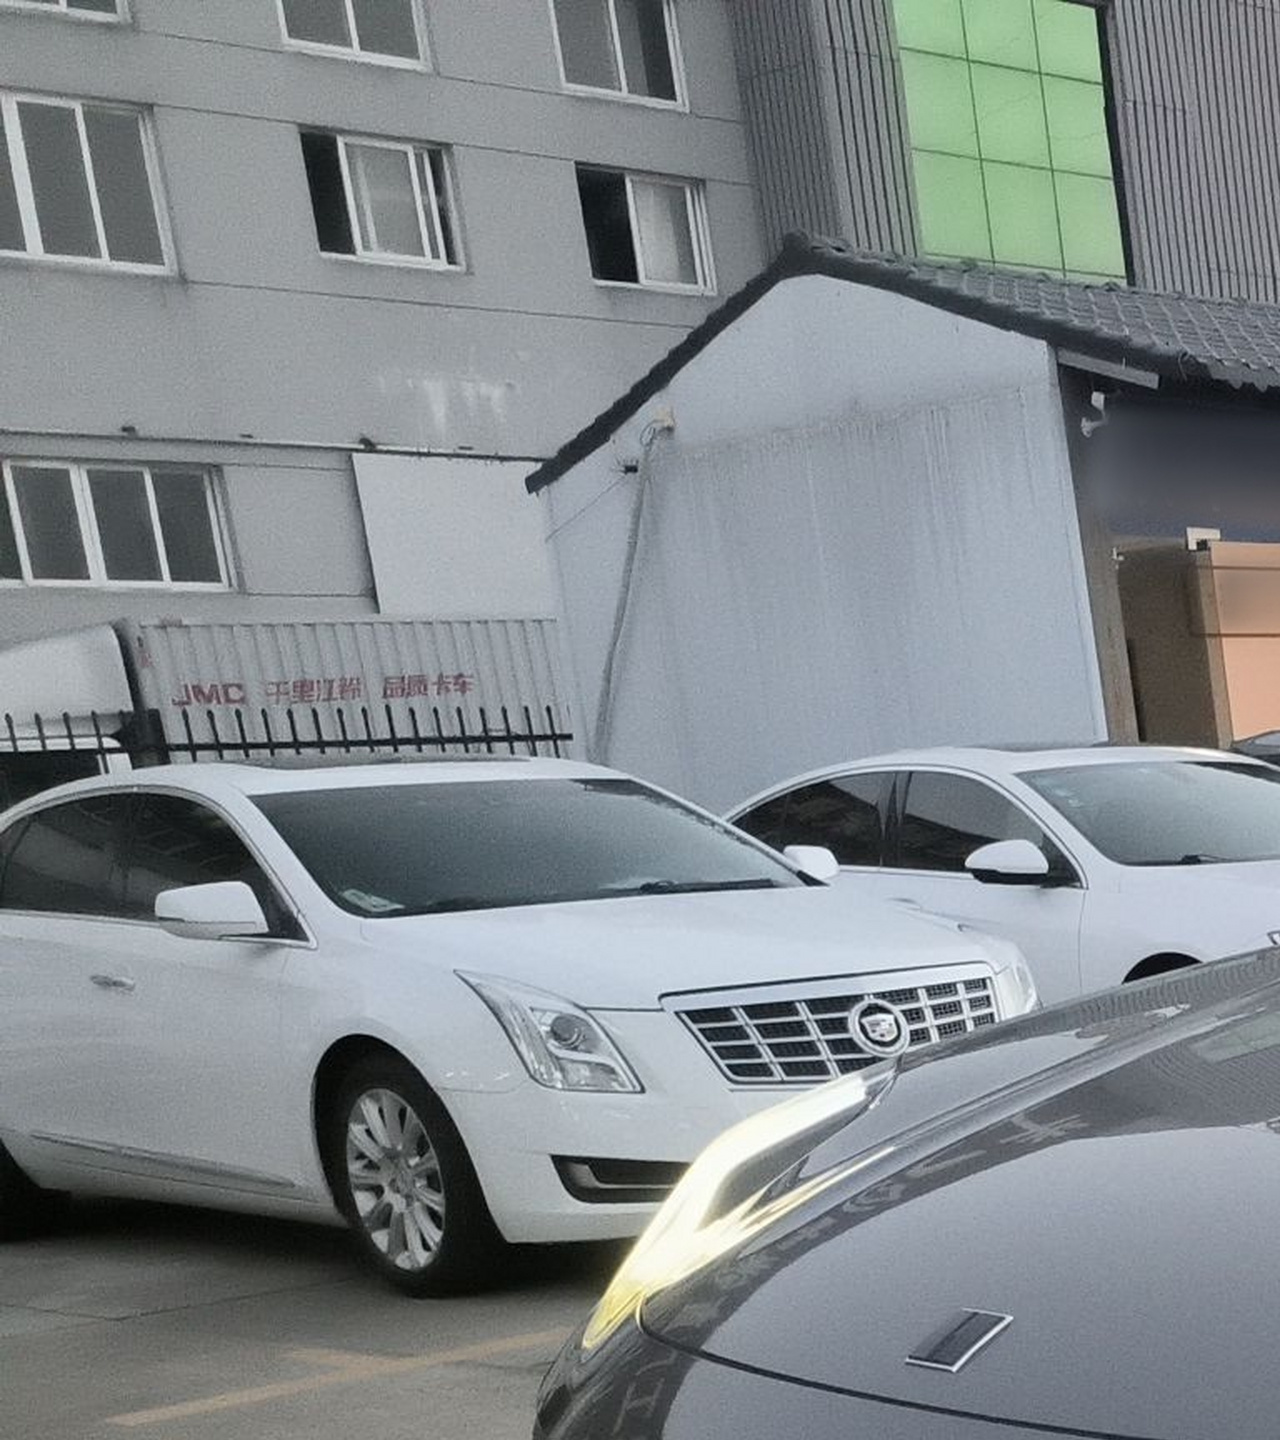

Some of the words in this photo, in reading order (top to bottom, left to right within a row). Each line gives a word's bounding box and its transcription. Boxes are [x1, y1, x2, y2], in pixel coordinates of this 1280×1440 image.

[172, 682, 247, 706] JMC
[382, 672, 474, 699] 品质卡车
